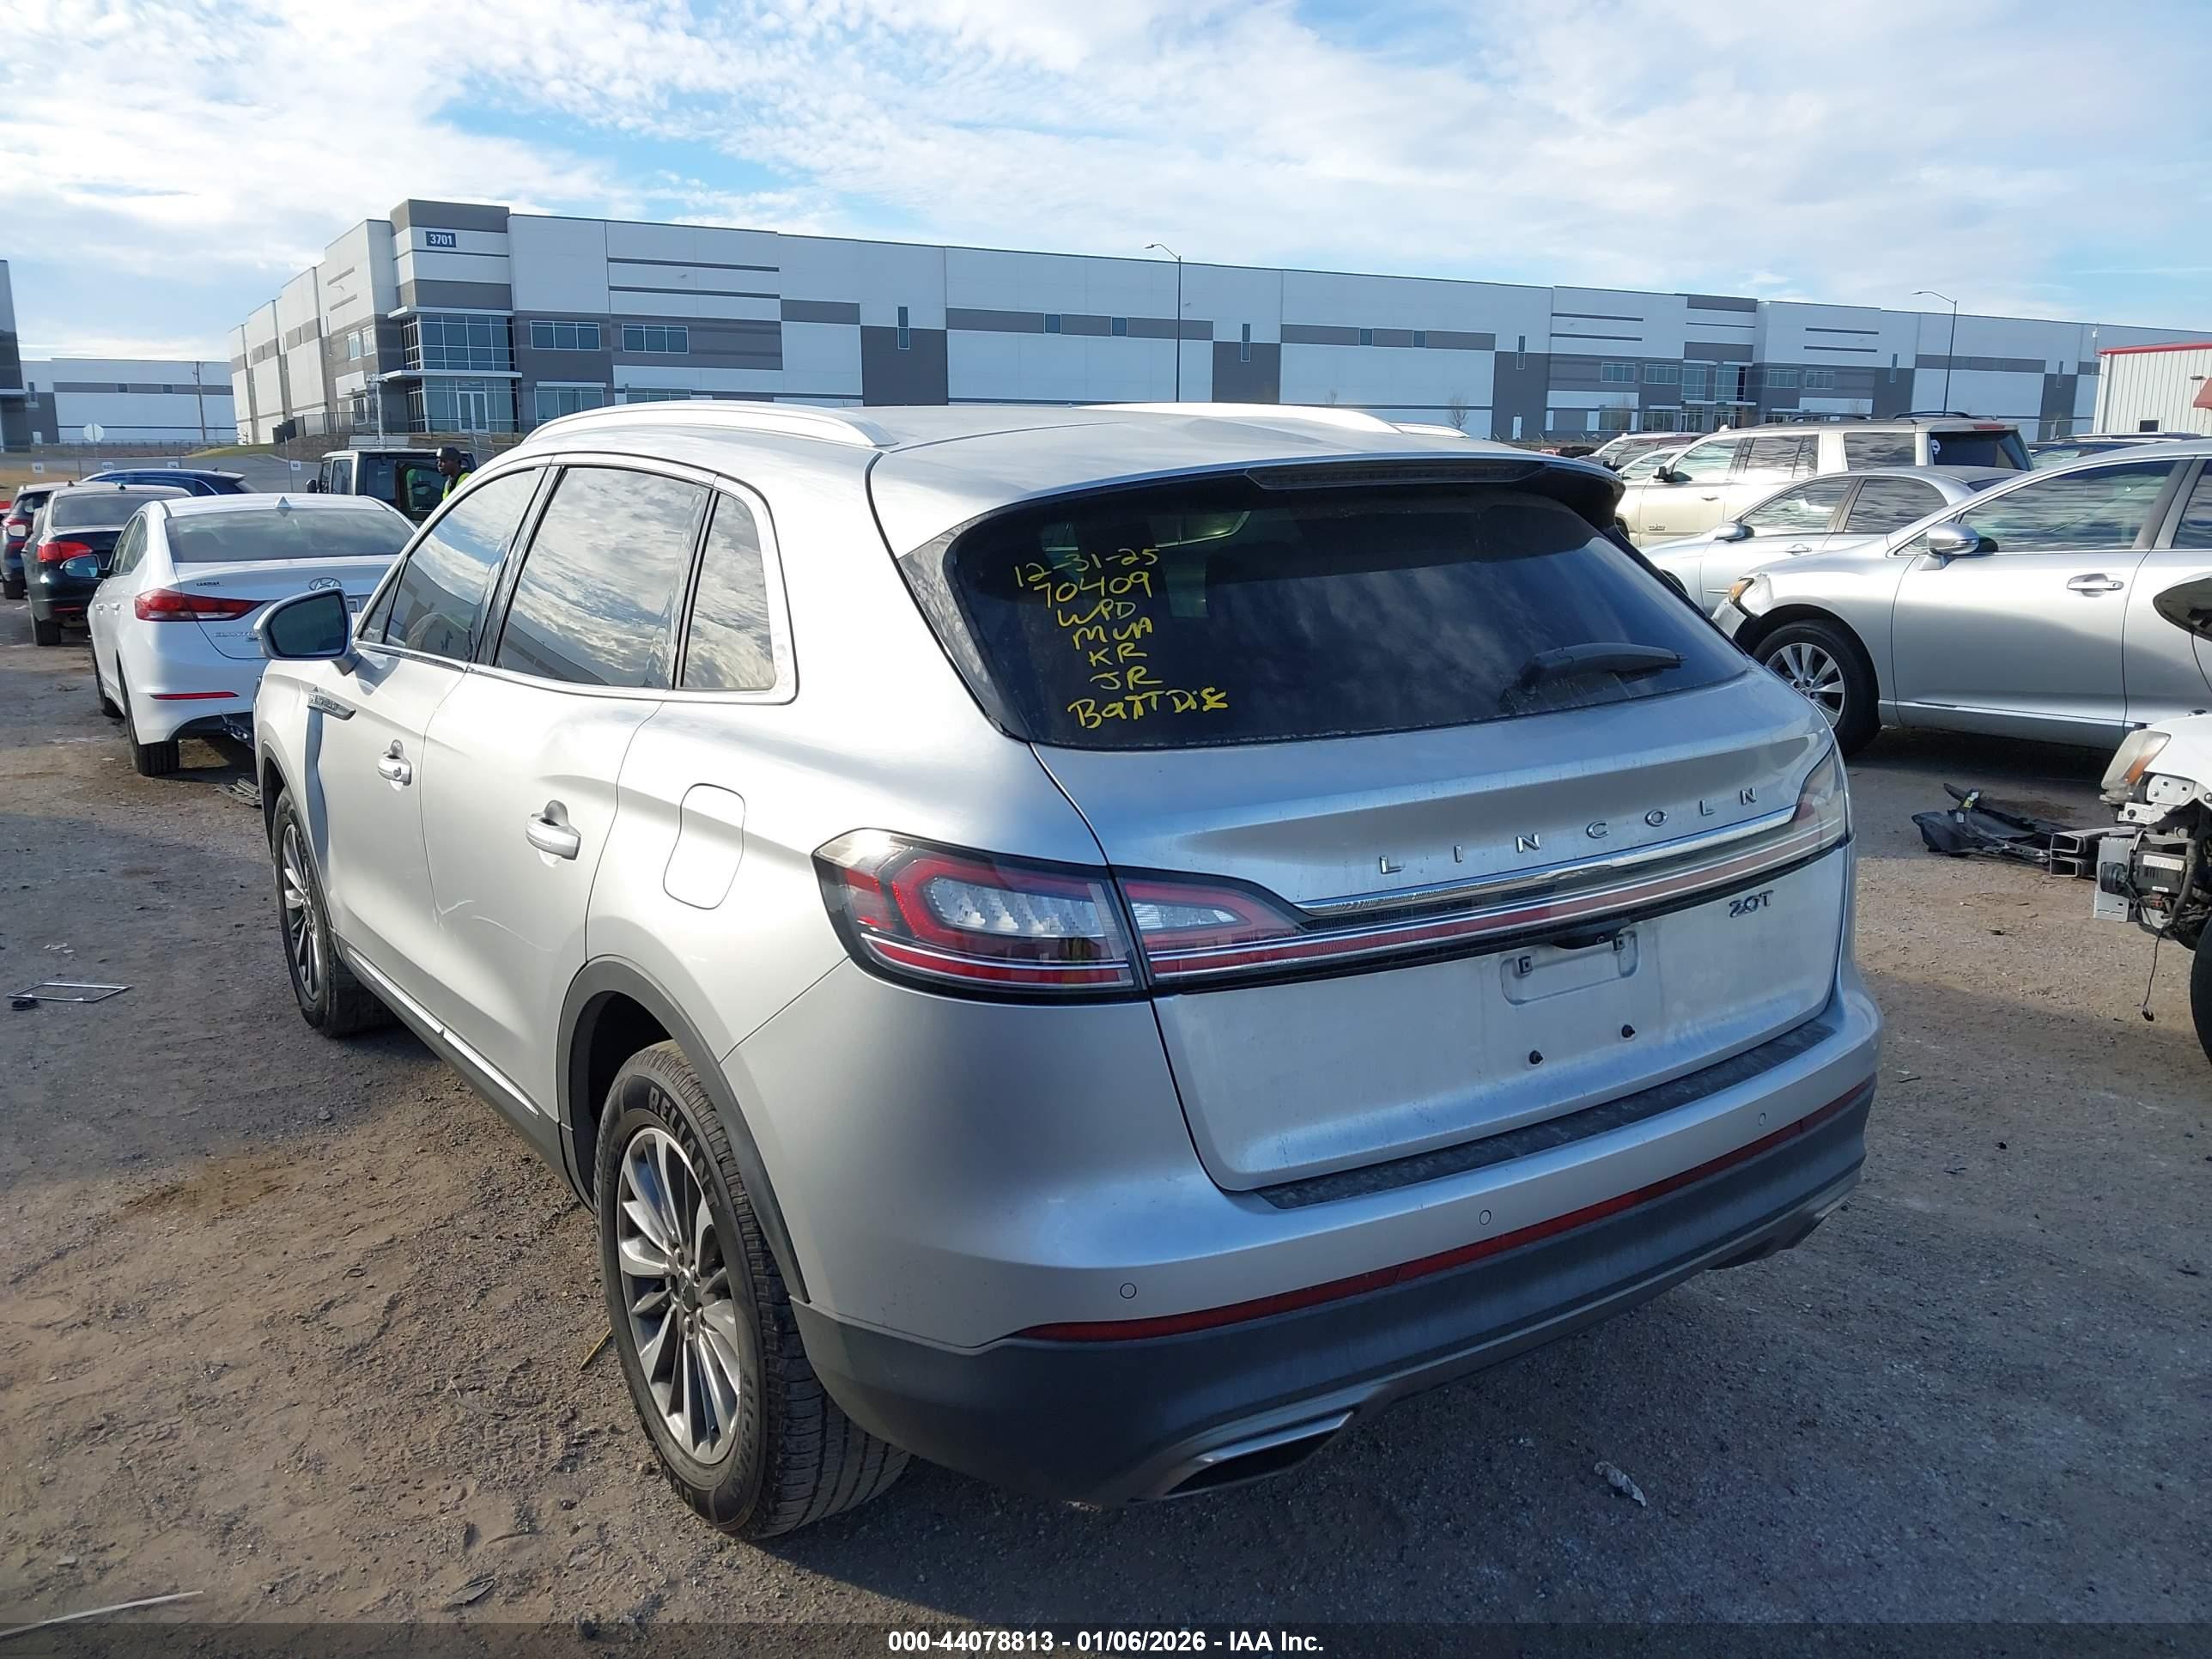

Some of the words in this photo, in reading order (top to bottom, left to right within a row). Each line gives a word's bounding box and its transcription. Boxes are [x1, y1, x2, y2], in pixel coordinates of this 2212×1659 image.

[429, 234, 453, 246] 3701
[1014, 548, 1159, 587] 12-31-25
[1379, 787, 1758, 874] LINCOLN
[648, 1086, 720, 1208] RELIANT
